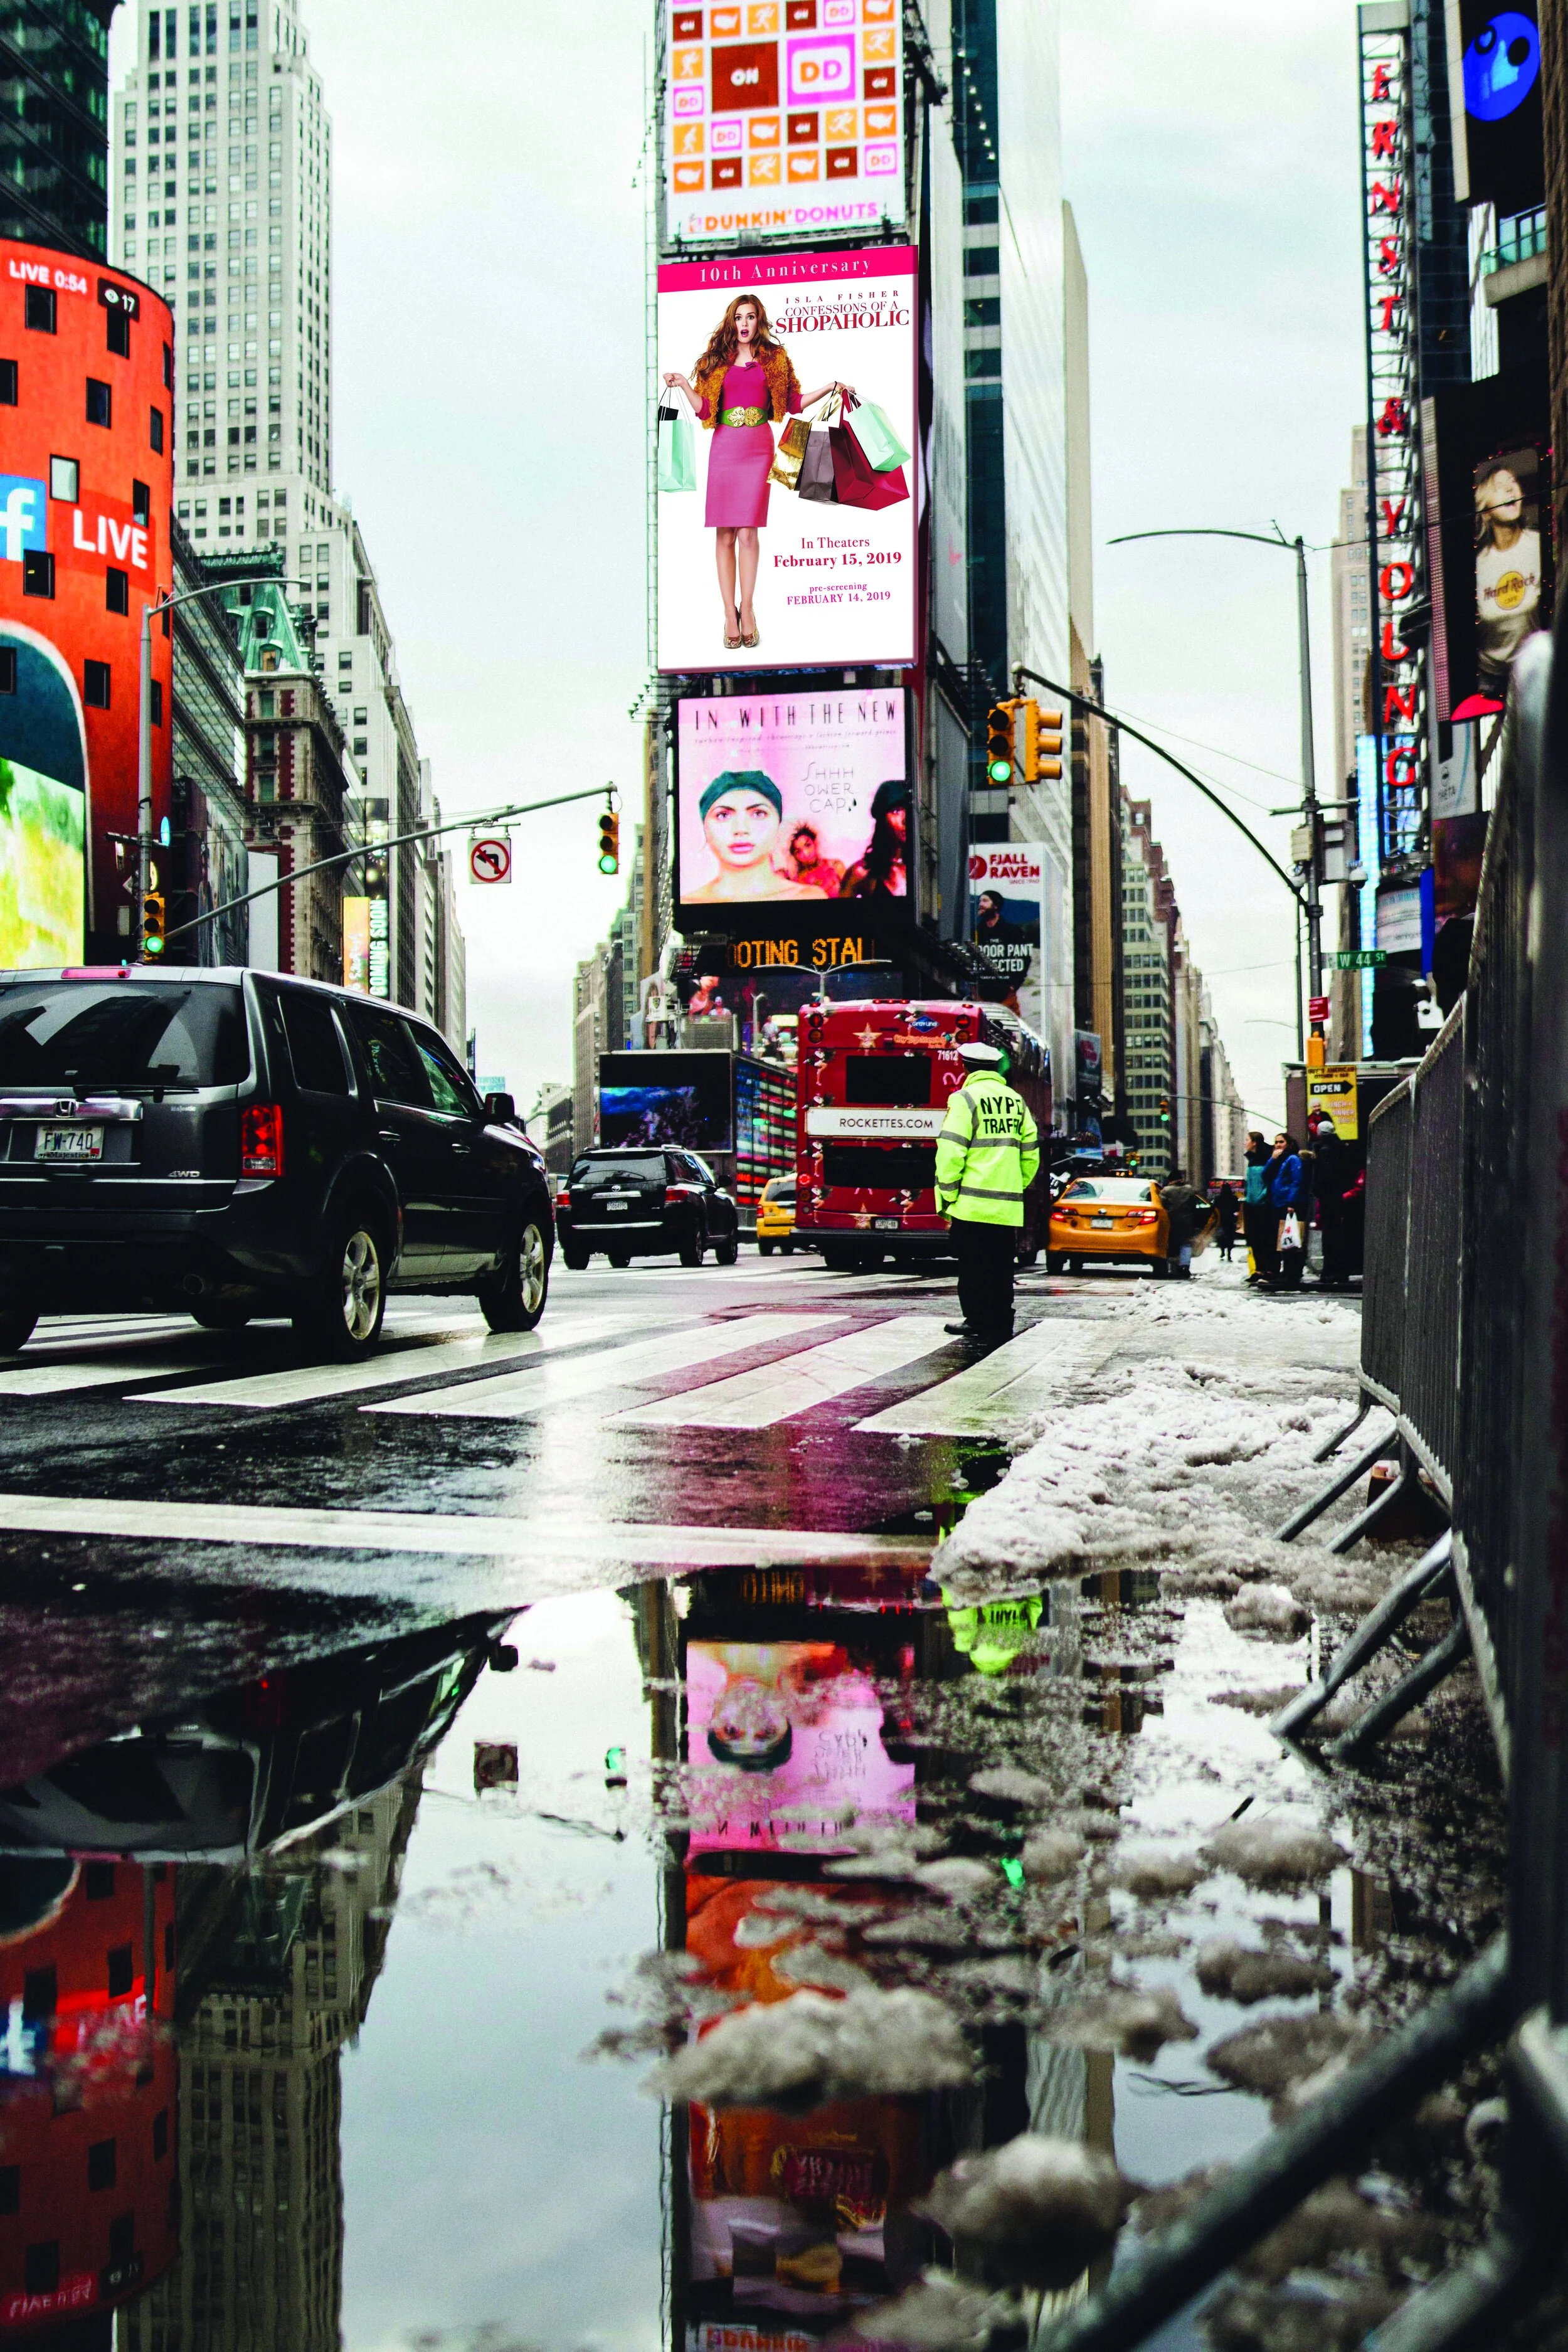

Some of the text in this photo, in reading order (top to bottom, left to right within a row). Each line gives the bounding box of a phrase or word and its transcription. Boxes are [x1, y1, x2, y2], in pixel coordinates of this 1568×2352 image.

[1371, 64, 1401, 331] ERNST
[704, 202, 878, 232] DUNKIN' DONUTS
[9, 259, 88, 295] LIVE 0:54
[700, 258, 872, 283] 10th Anniversary
[122, 294, 135, 314] 17
[785, 290, 899, 305] ISLA FISHER
[785, 300, 899, 317] CONFESSIONS OF A
[775, 309, 910, 334] SHOPAHOLIC
[73, 509, 148, 570] LIVE
[801, 537, 871, 549] In Theaters
[773, 551, 902, 569] February 15, 2019
[809, 582, 868, 595] pre-screening
[787, 591, 891, 606] FEBRUARY 14, 2019
[695, 700, 896, 731] IN WITH THE NEW
[804, 782, 854, 796] OWER
[809, 797, 847, 814] CAP
[369, 899, 388, 938] SOON
[1007, 943, 1034, 957] PANT
[1340, 954, 1350, 967] W
[1356, 953, 1371, 967] 44
[369, 941, 388, 997] COMING
[937, 1050, 959, 1061] 71612
[1313, 1084, 1342, 1093] OPEN
[839, 1118, 933, 1129] ROCKETTES.COM
[45, 1133, 93, 1150] FW-740
